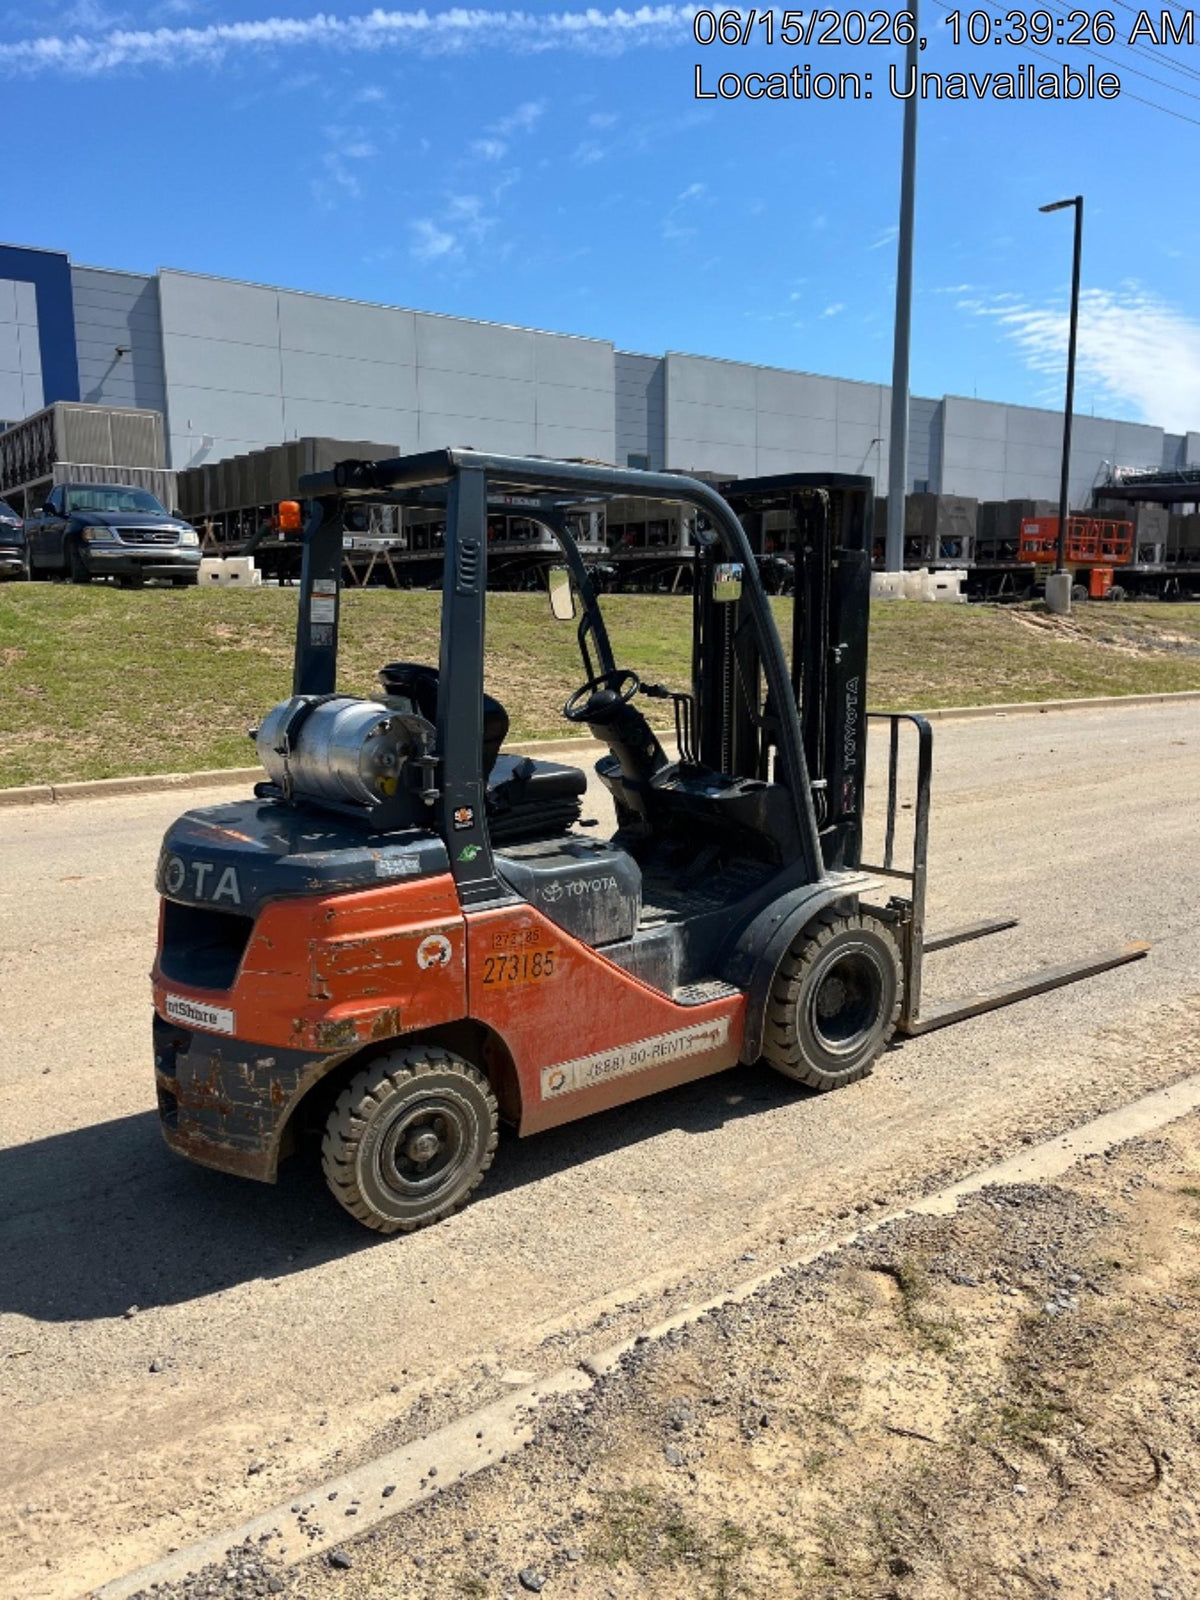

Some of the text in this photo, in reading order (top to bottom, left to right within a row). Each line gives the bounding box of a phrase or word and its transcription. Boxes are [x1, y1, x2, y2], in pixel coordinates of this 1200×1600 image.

[843, 676, 860, 770] TOYOTA
[564, 875, 618, 897] TOYOTA
[482, 950, 554, 984] 273185
